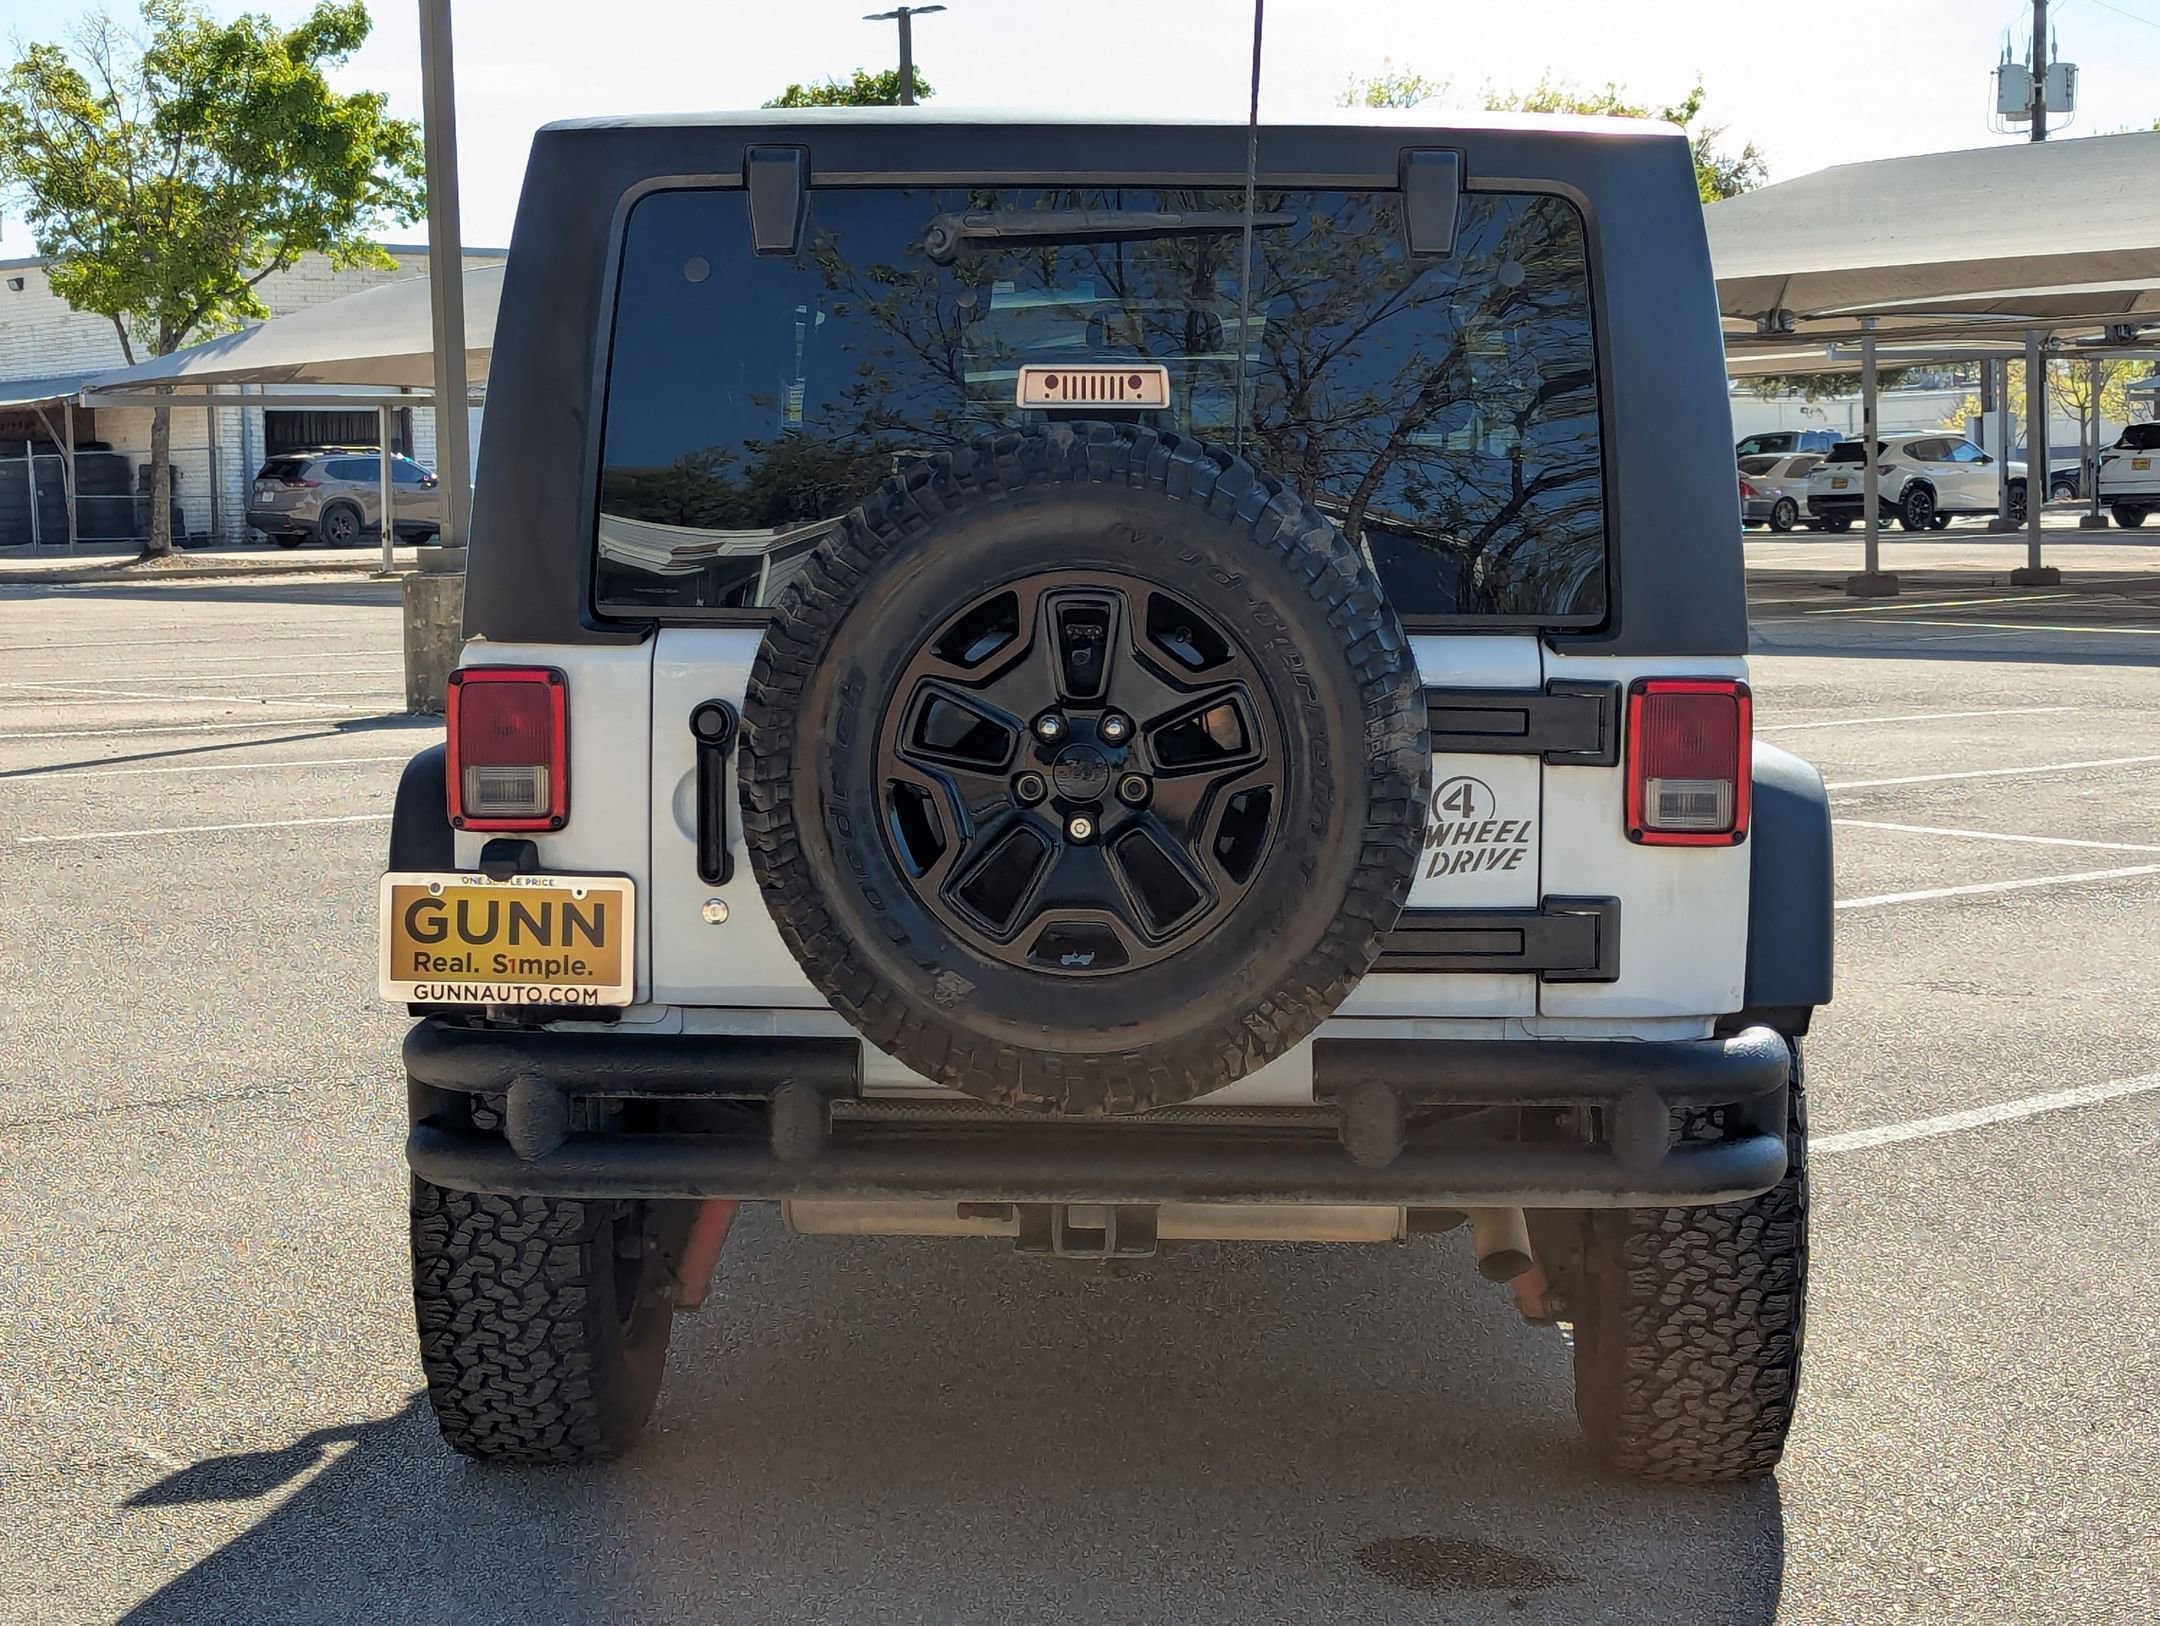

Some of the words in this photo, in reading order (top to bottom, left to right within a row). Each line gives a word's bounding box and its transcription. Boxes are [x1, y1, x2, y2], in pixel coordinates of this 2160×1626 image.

[1442, 783, 1475, 819] 4
[1425, 820, 1532, 850] WHEEL
[1425, 847, 1528, 879] DRIVE
[461, 875, 484, 886] ONE
[525, 877, 555, 888] PRICE
[404, 897, 605, 948] GUNN
[413, 951, 480, 974] Real.
[413, 984, 599, 1006] GUNNAUTO.COM
